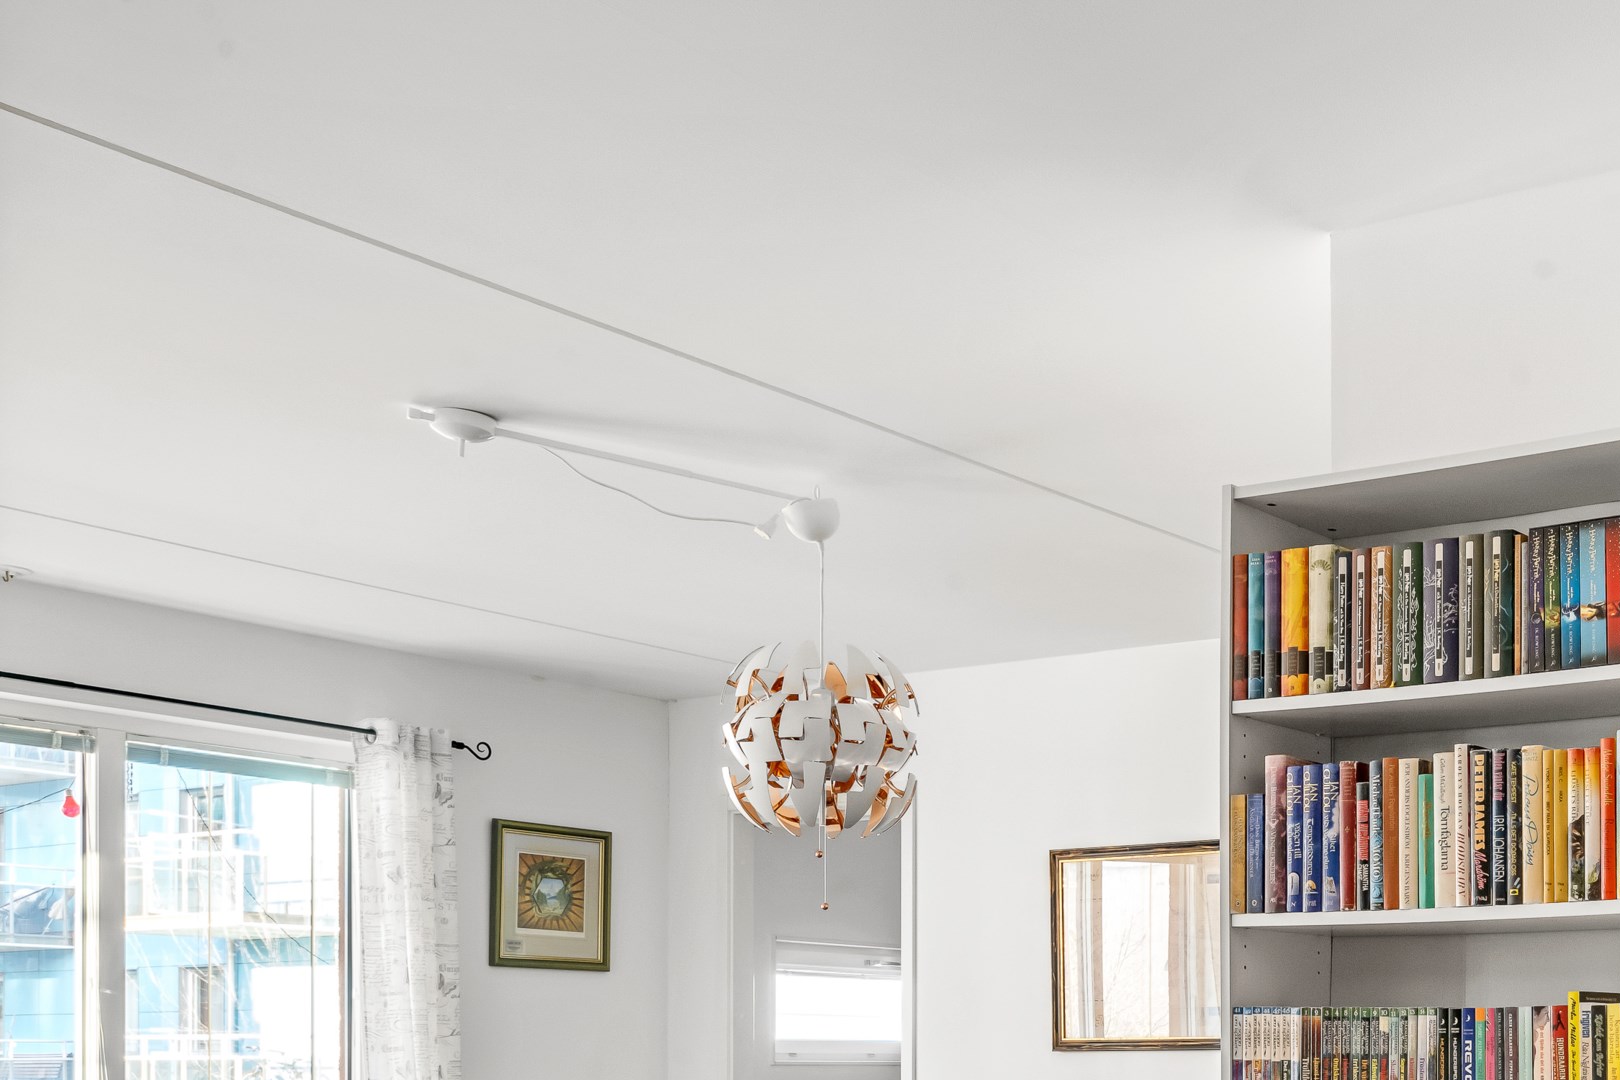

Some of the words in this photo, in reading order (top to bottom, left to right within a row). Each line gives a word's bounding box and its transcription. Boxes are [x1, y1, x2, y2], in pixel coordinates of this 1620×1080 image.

[1372, 774, 1381, 810] Michael
[1474, 754, 1484, 803] PETER
[1474, 803, 1485, 850] JAMES
[1494, 815, 1504, 831] IRIS
[1494, 836, 1505, 882] JOHANSEN
[1580, 1010, 1590, 1038] Frigiven
